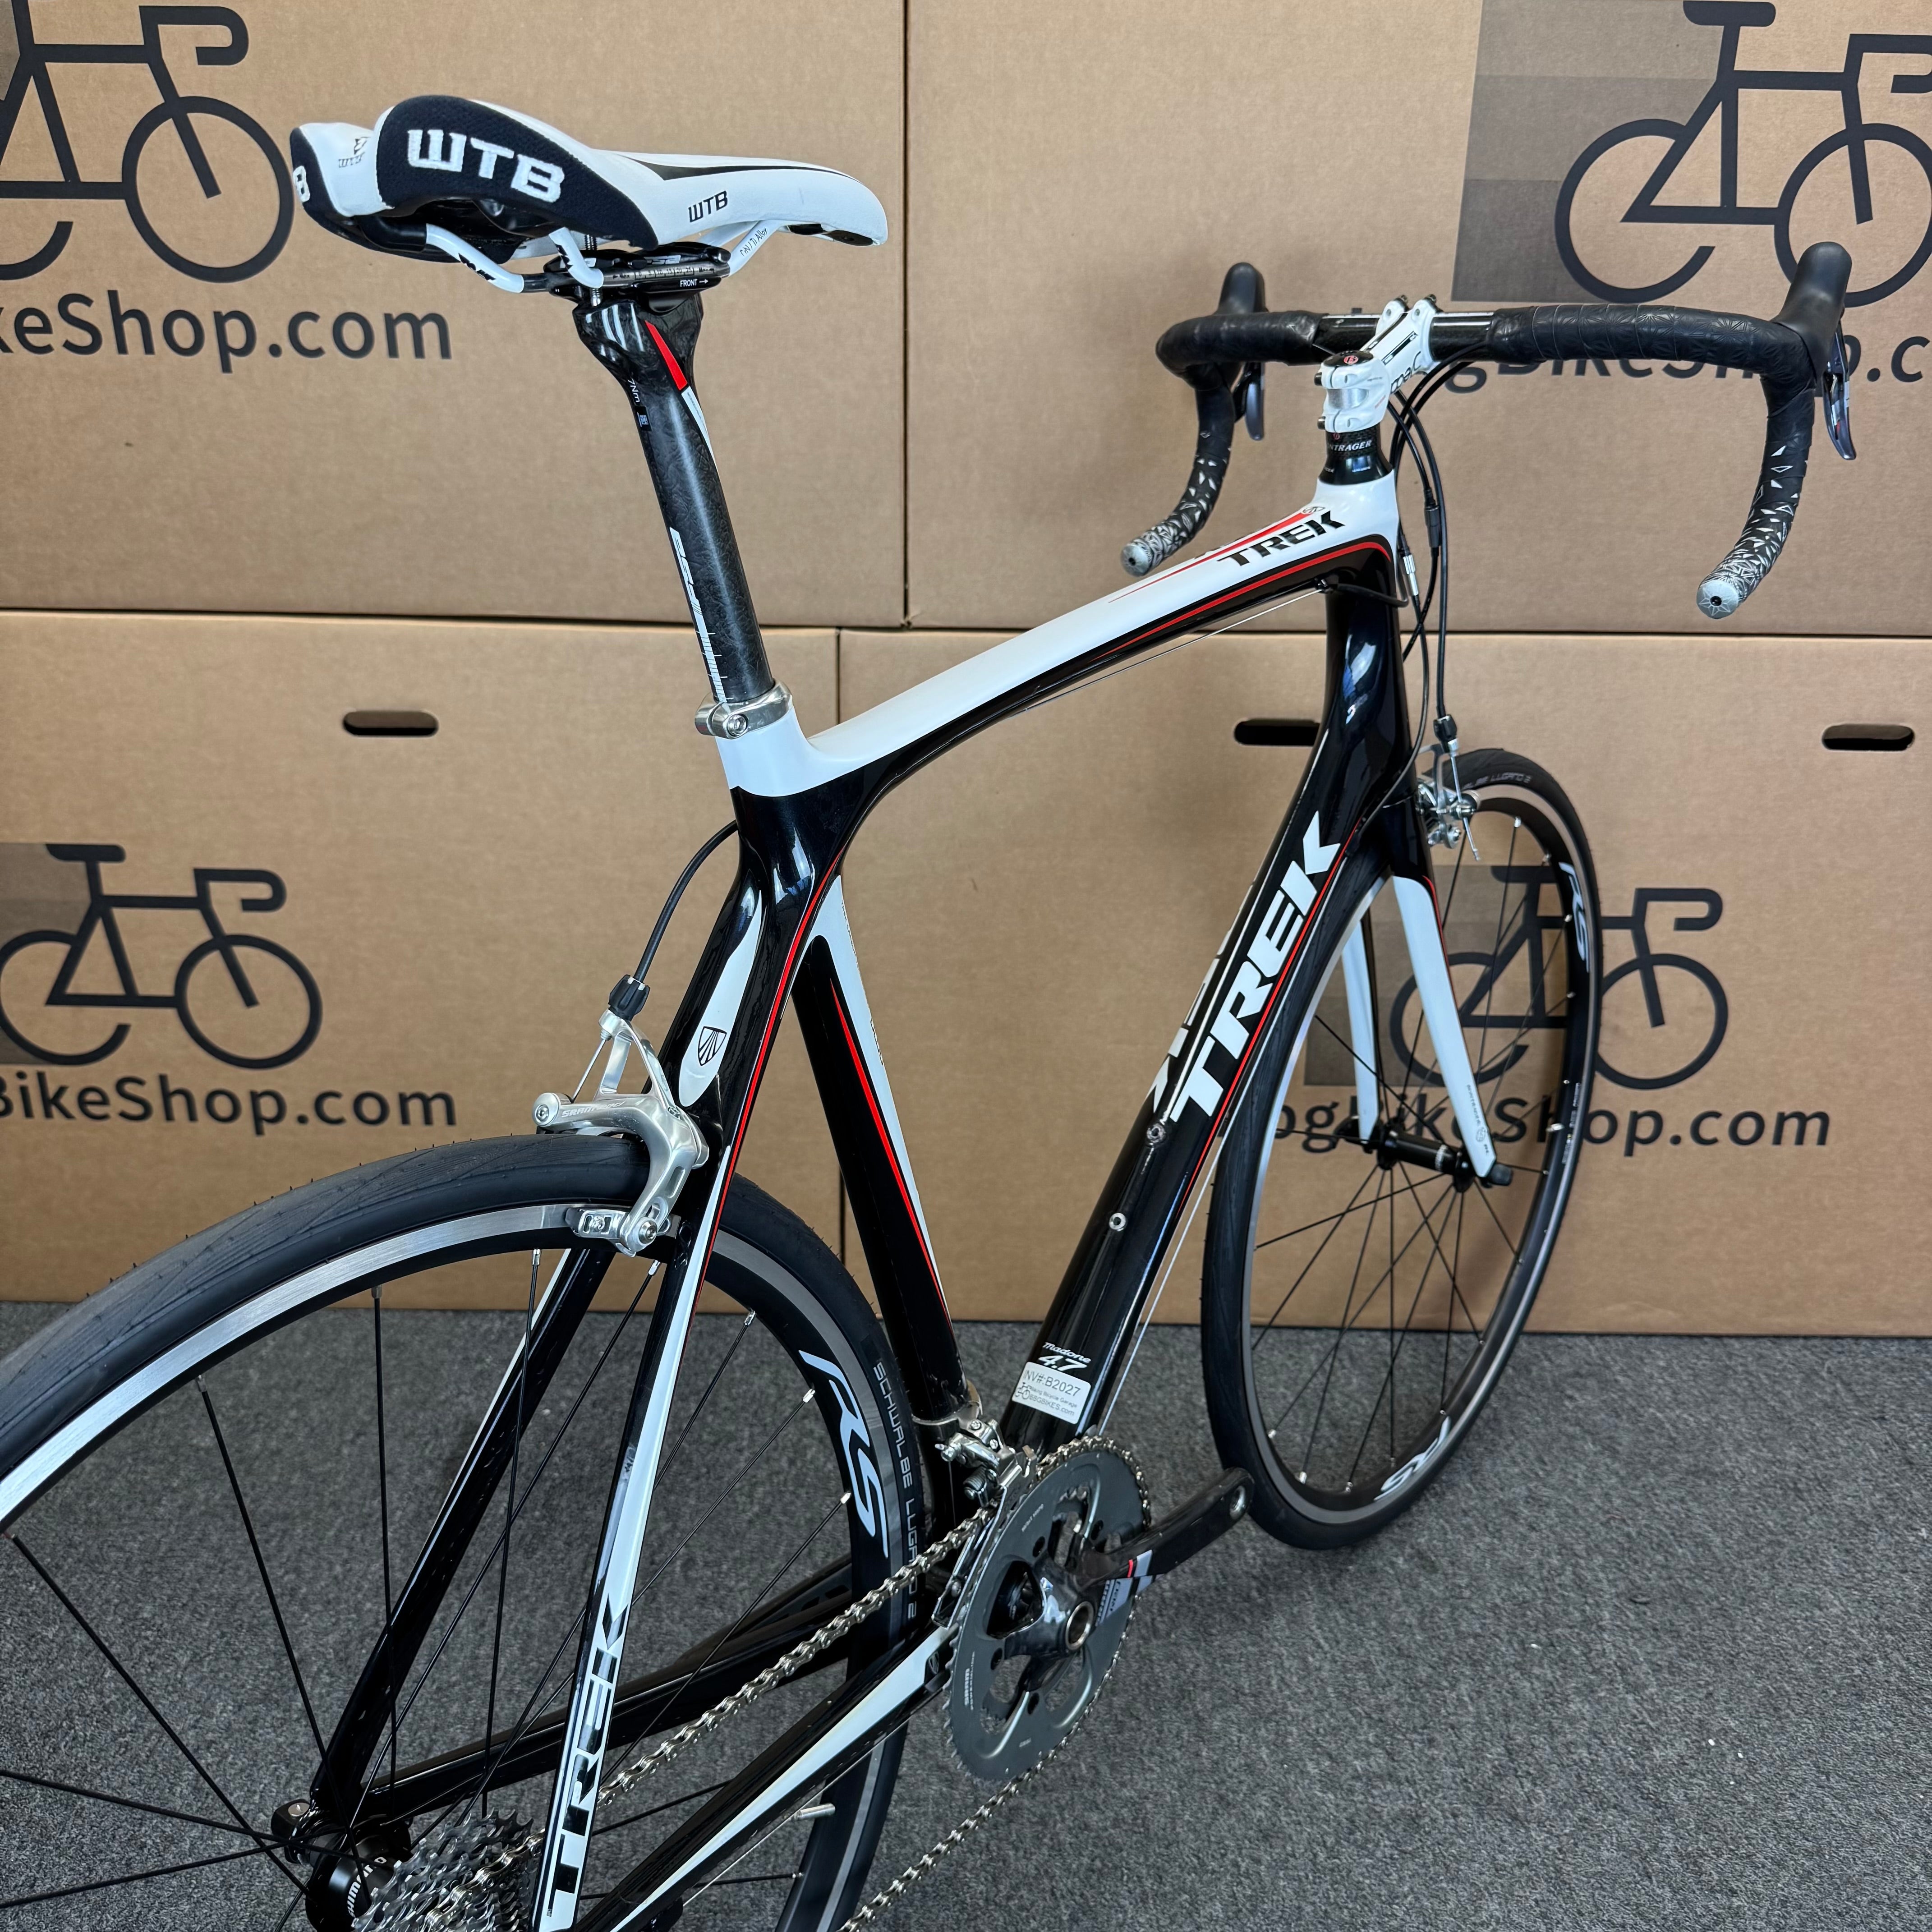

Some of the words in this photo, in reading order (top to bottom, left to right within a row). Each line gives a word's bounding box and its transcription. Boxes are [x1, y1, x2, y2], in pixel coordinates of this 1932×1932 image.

[407, 129, 565, 203] WTB
[688, 190, 729, 223] WTB
[680, 279, 698, 287] FRONT
[627, 378, 640, 403] 7Nm
[1216, 511, 1345, 566] TREK
[1169, 810, 1341, 1122] TREK
[1038, 1355, 1088, 1371] 4.7
[1042, 1342, 1092, 1363] Madone
[873, 1362, 913, 1489] SCHWALBE
[906, 1498, 918, 1595] LUGAO
[907, 1601, 917, 1620] 2
[546, 1593, 629, 1917] TREK
